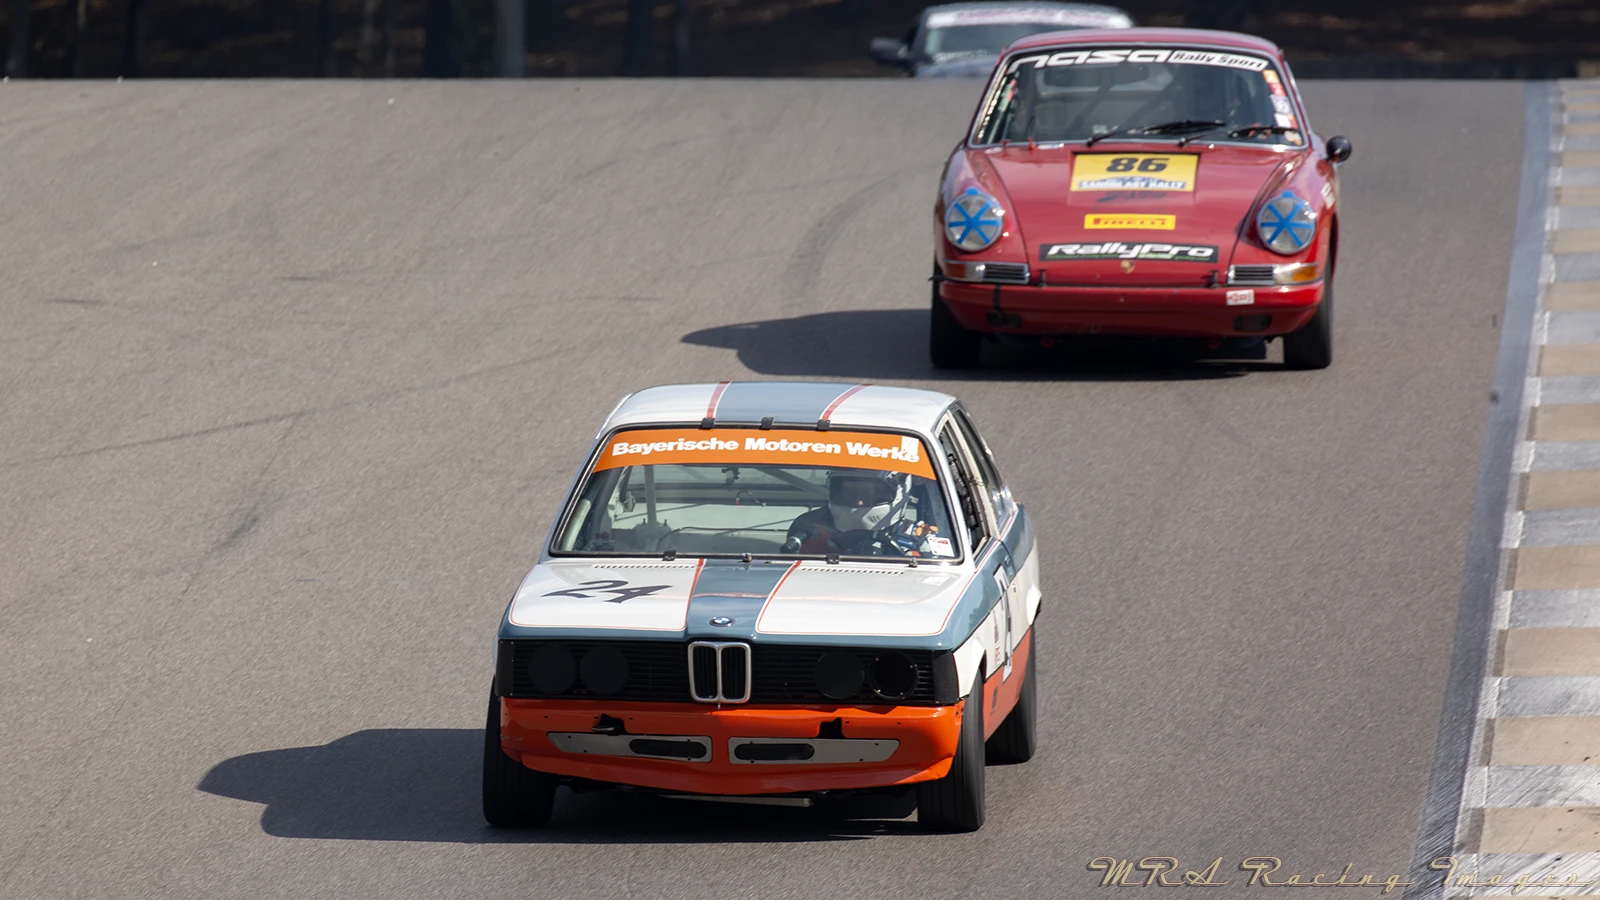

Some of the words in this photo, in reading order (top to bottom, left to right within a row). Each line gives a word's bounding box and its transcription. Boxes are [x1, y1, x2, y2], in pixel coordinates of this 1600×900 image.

[1174, 52, 1215, 63] Rally
[1218, 55, 1262, 69] Sport
[1105, 157, 1170, 173] 86
[1047, 242, 1214, 259] RallyPro
[612, 437, 740, 457] Bayerische
[744, 437, 841, 455] Motoren
[540, 579, 673, 604] 24
